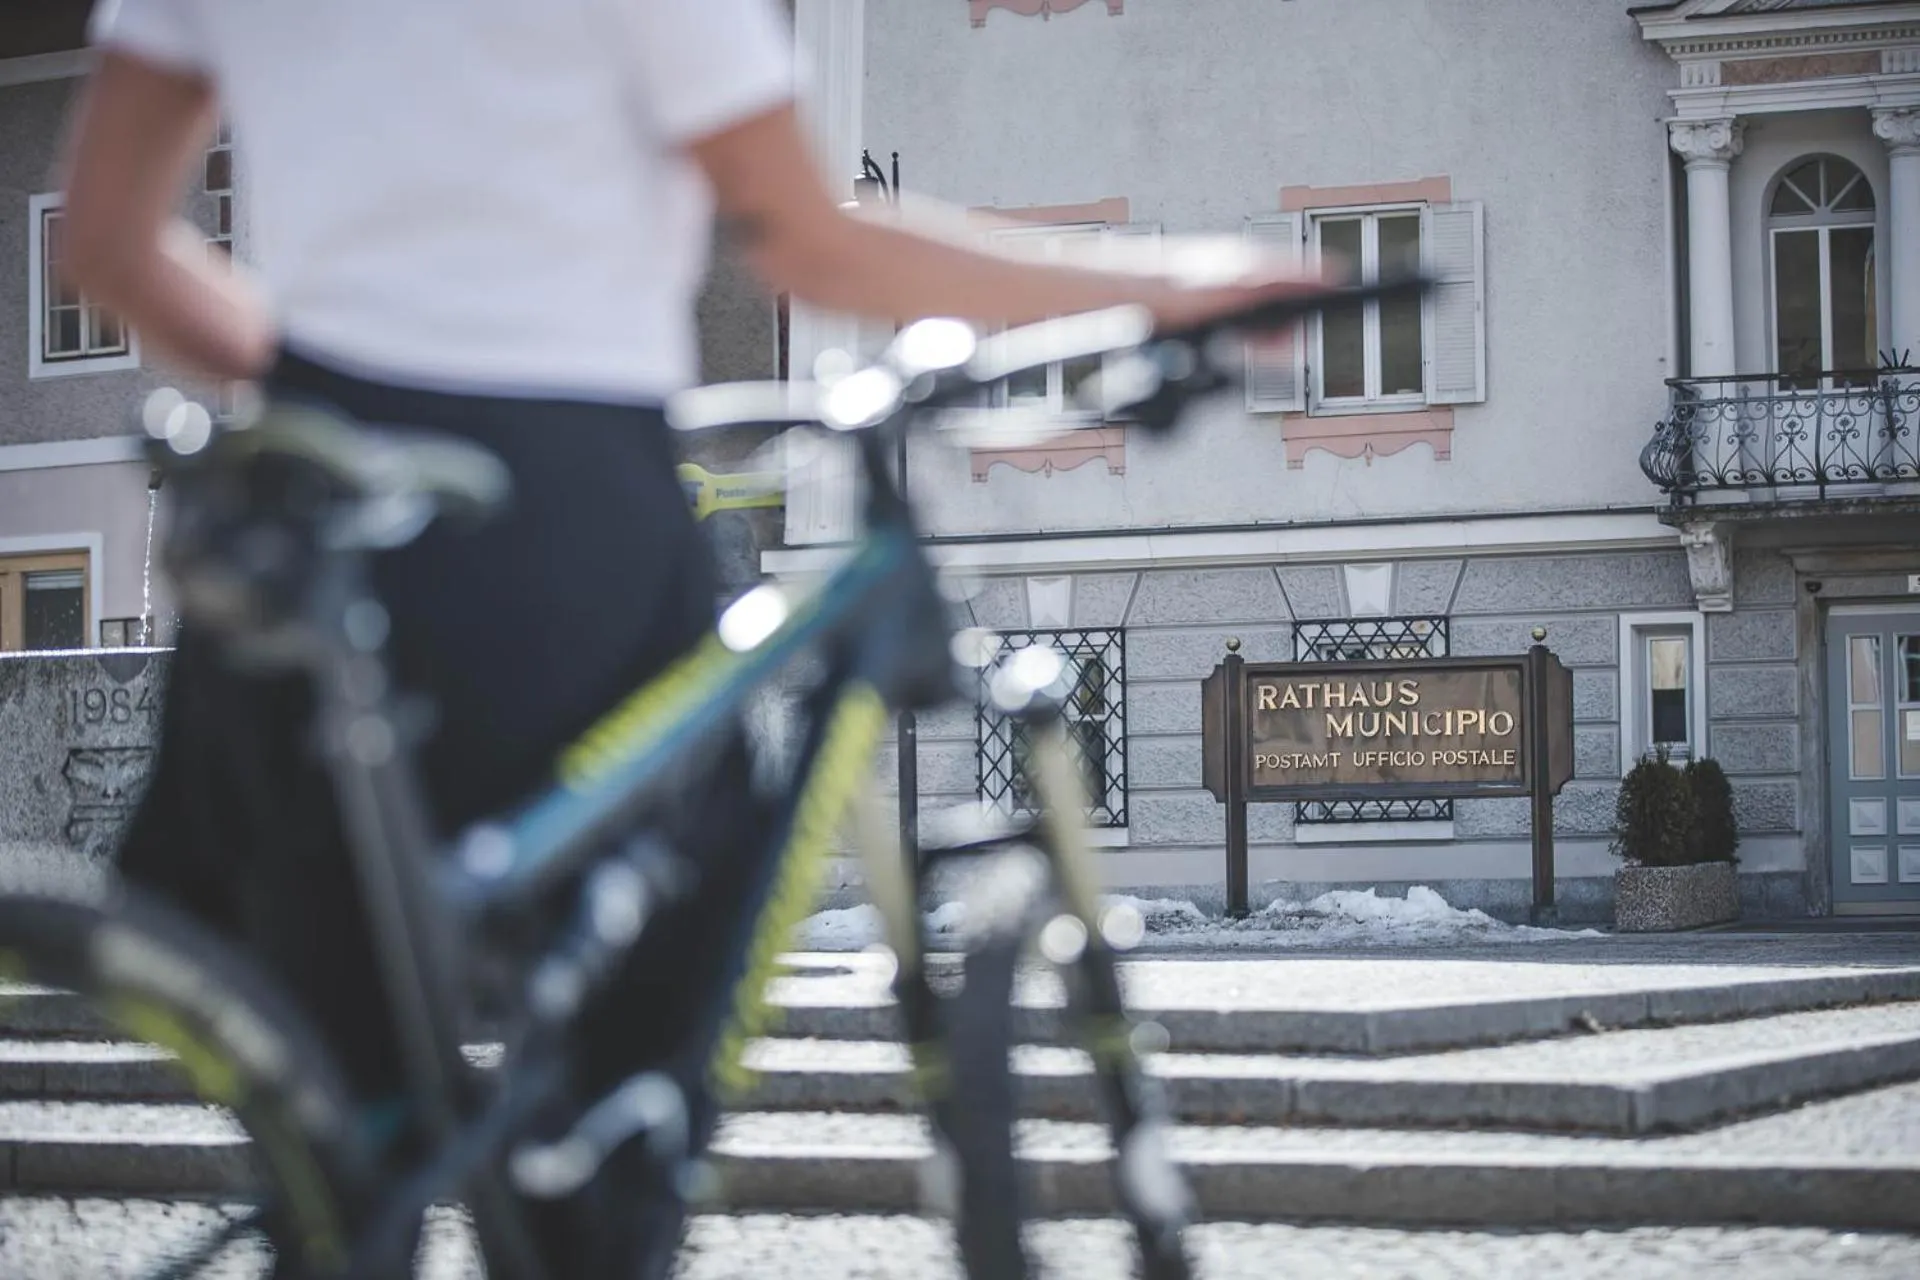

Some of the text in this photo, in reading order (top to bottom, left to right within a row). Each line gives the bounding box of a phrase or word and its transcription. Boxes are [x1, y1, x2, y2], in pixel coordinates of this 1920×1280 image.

[72, 686, 156, 725] 1984
[1257, 680, 1420, 710] RATHAUS
[1326, 708, 1515, 738] MUNICIPIO
[1256, 749, 1516, 769] POSTAMT UFFICIO POSTALE
